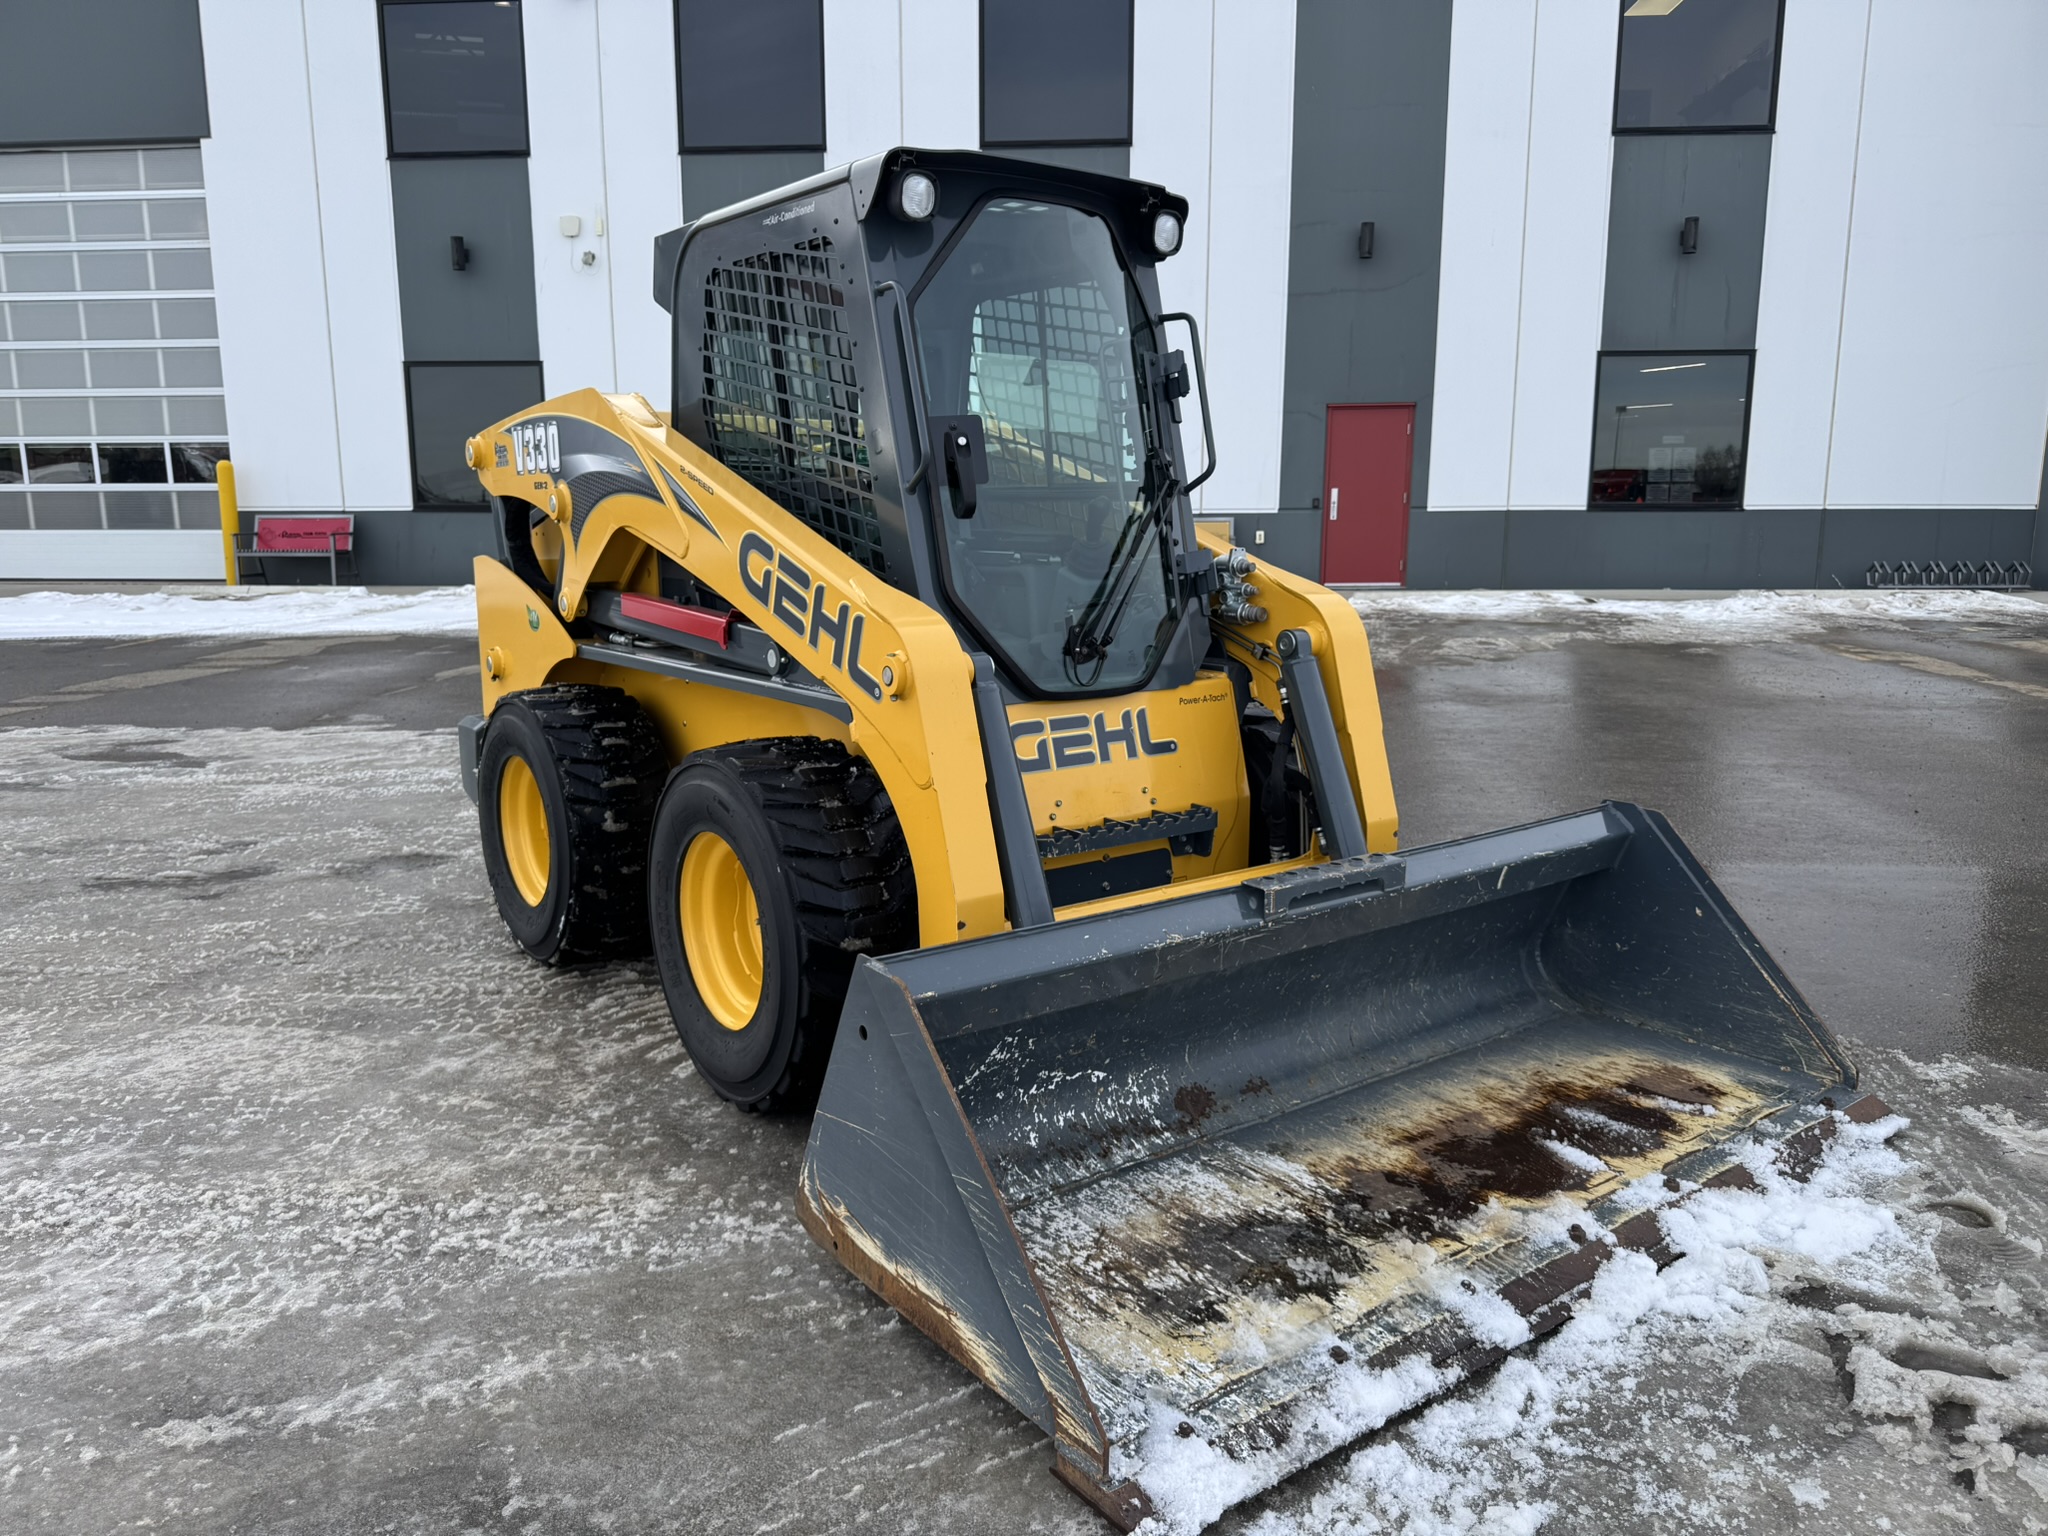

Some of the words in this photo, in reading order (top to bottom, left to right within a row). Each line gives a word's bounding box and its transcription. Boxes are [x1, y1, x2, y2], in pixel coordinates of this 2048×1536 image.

[770, 200, 815, 224] Air-Conditioned
[511, 420, 561, 476] V330
[679, 464, 714, 496] 2-SPEED
[739, 530, 882, 703] GEHL
[1011, 706, 1178, 773] GEHL
